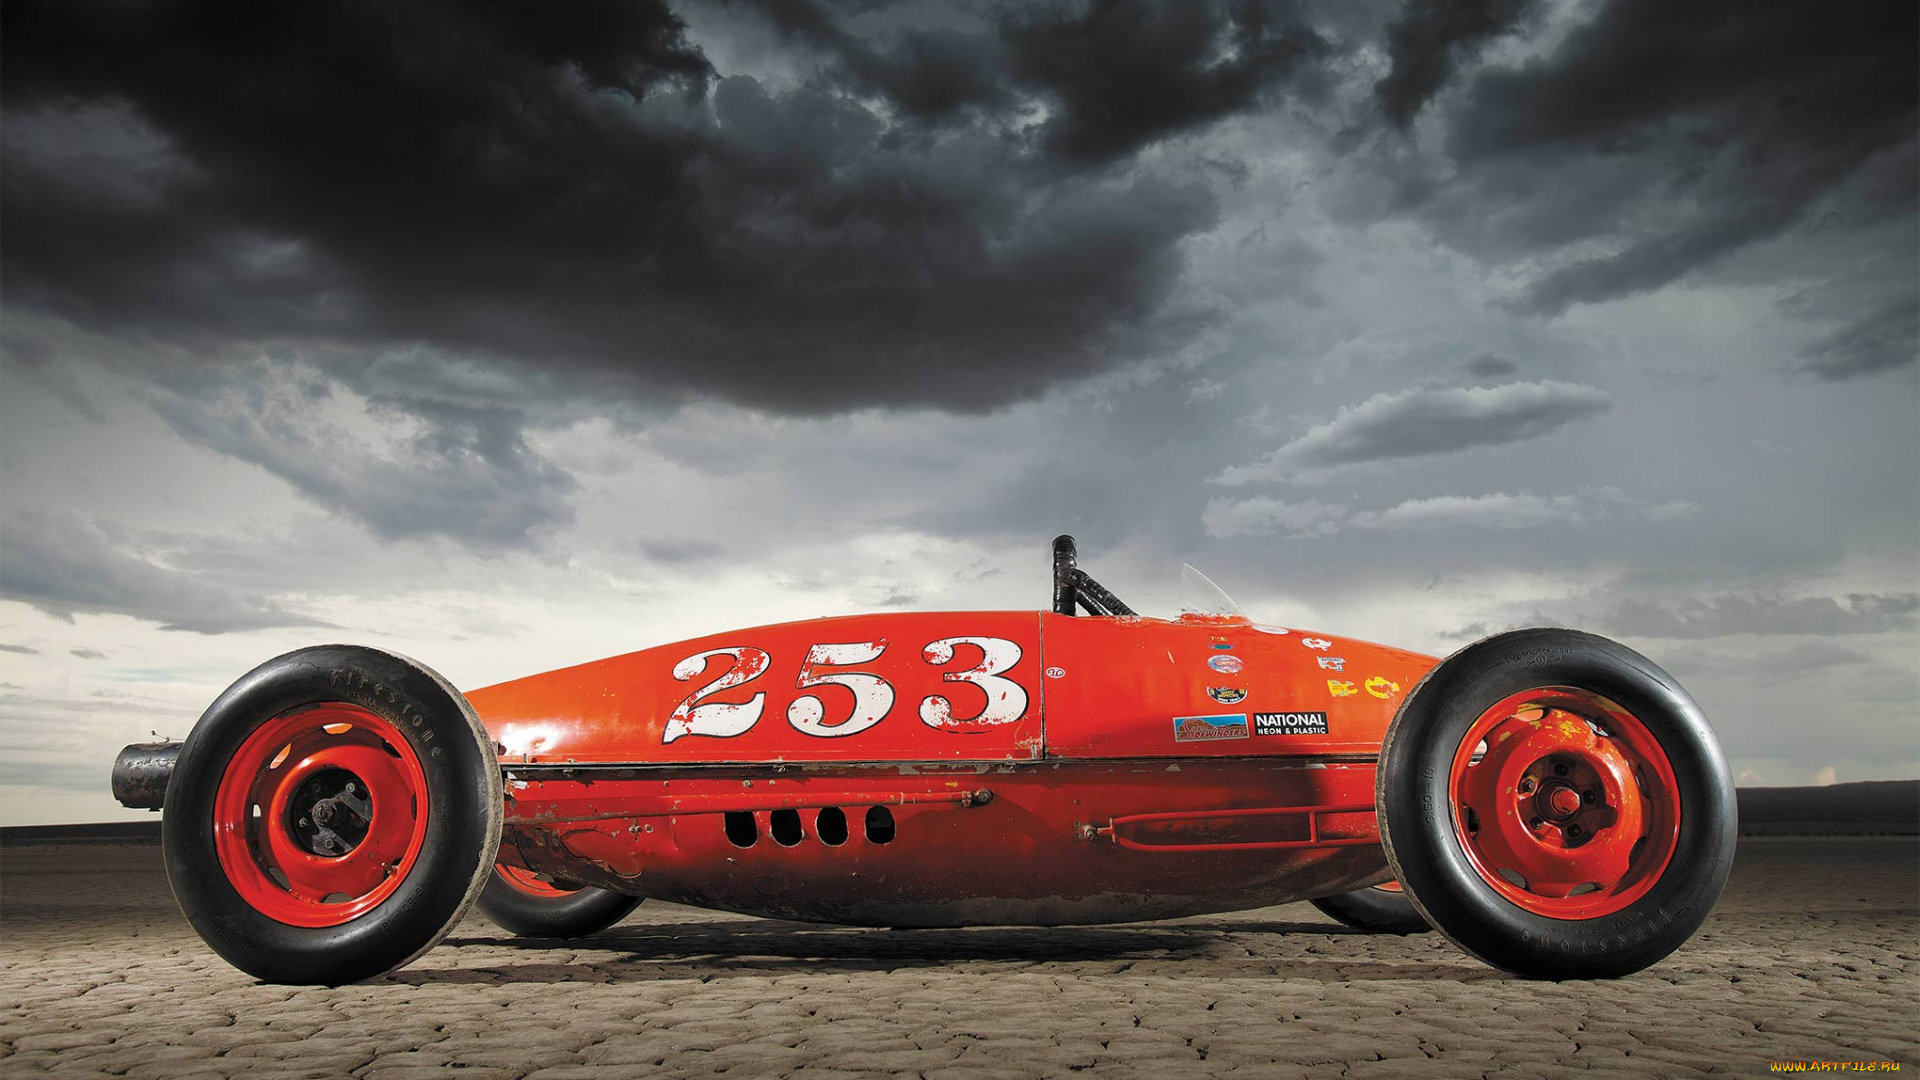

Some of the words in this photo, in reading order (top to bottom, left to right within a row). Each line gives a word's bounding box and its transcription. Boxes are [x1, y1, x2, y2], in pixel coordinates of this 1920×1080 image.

[661, 636, 1030, 745] 253
[1256, 713, 1325, 727] NATIONAL
[1182, 719, 1246, 739] SIDEWINDERS
[1294, 727, 1326, 735] PLASTIC
